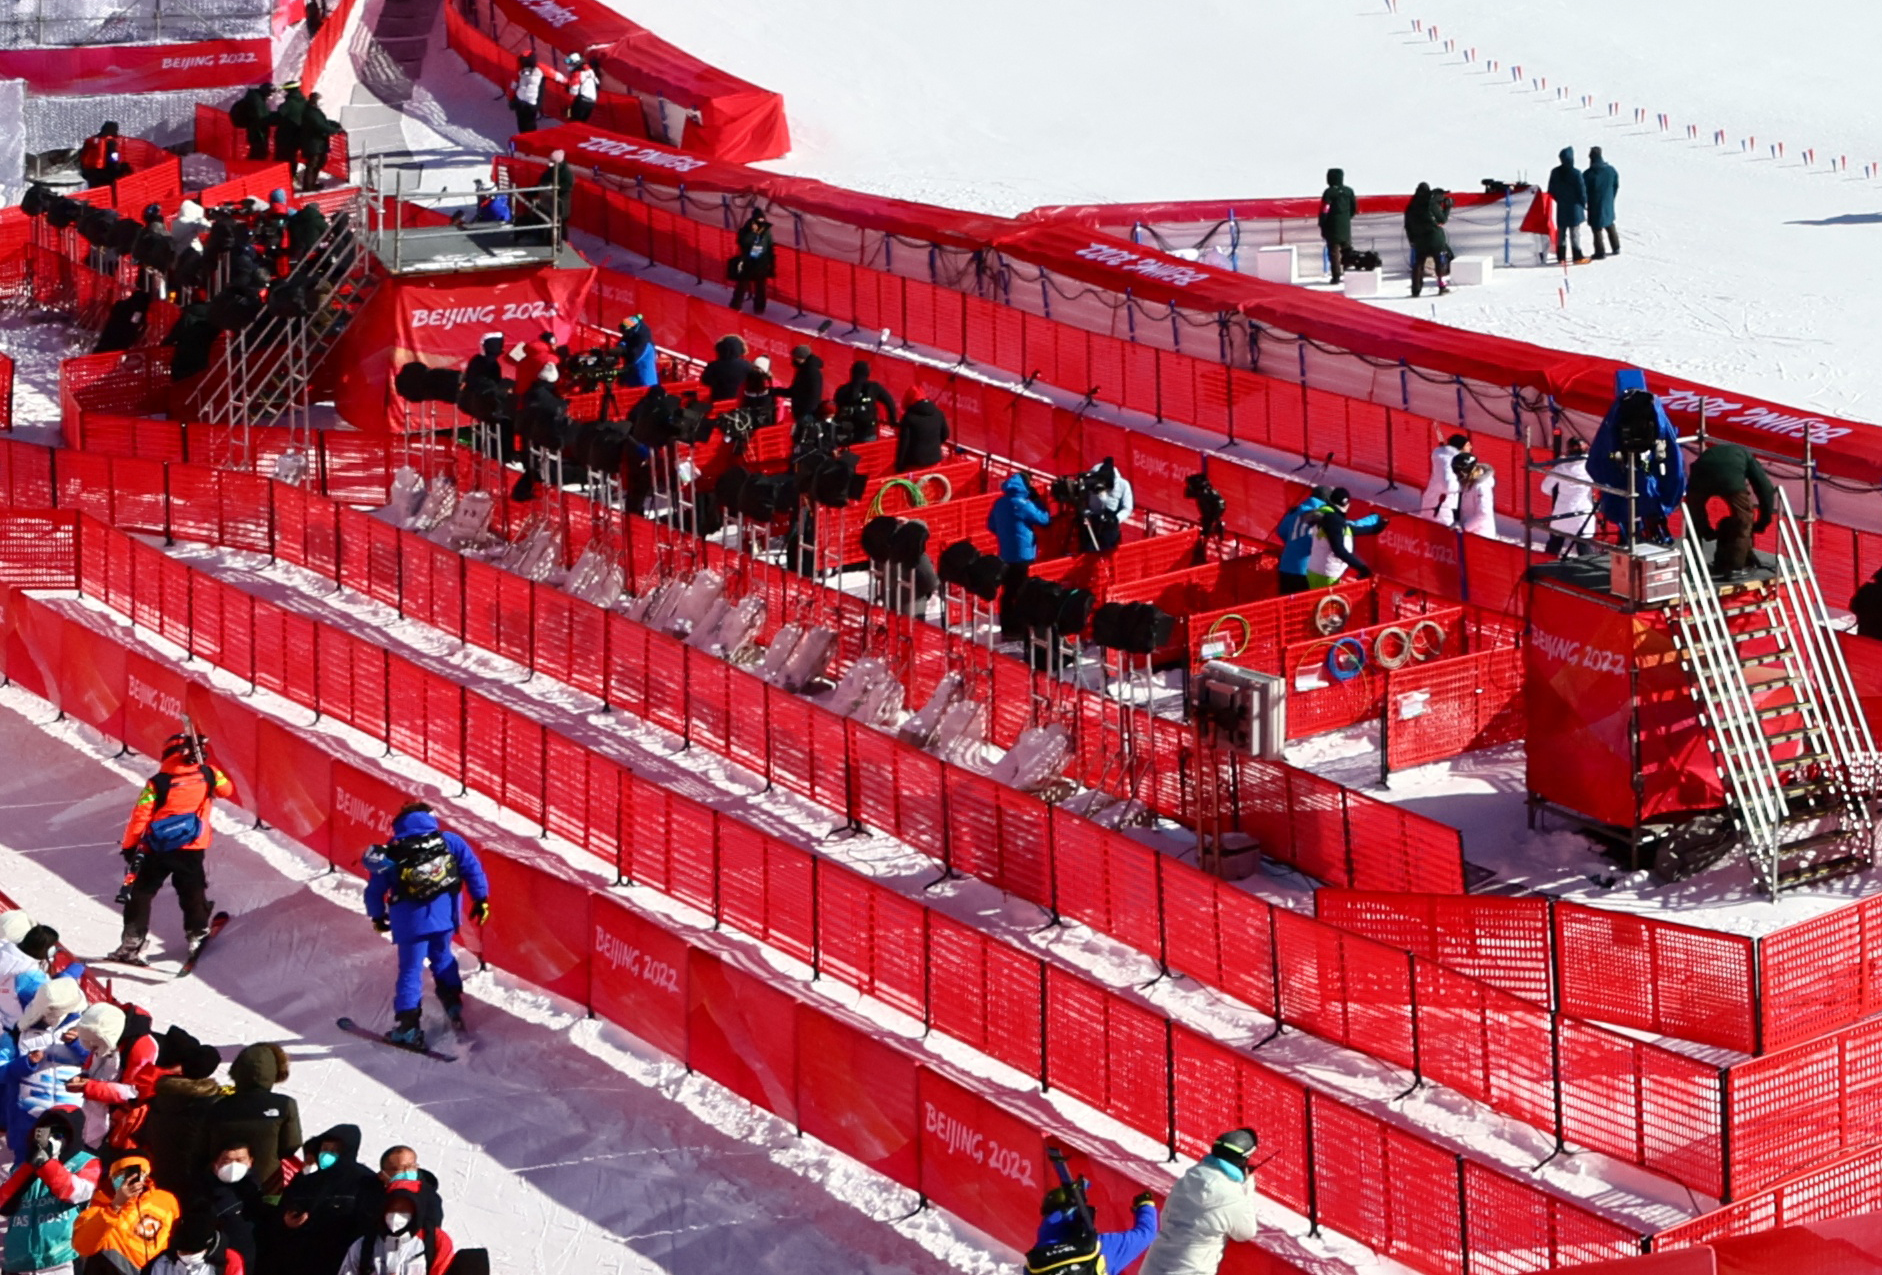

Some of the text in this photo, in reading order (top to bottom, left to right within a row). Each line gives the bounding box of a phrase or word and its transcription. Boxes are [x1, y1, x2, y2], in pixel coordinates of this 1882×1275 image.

[162, 52, 258, 70] BEIJING 2022
[412, 305, 496, 330] BEIJING
[1727, 406, 1852, 444] BEIJING
[1531, 625, 1626, 675] BEIJING 2022
[128, 674, 182, 720] BEIJING 2022
[336, 786, 396, 836] BEIJING 20
[595, 925, 682, 994] BEIJING 2022
[924, 1102, 1037, 1187] BEIJING 2022
